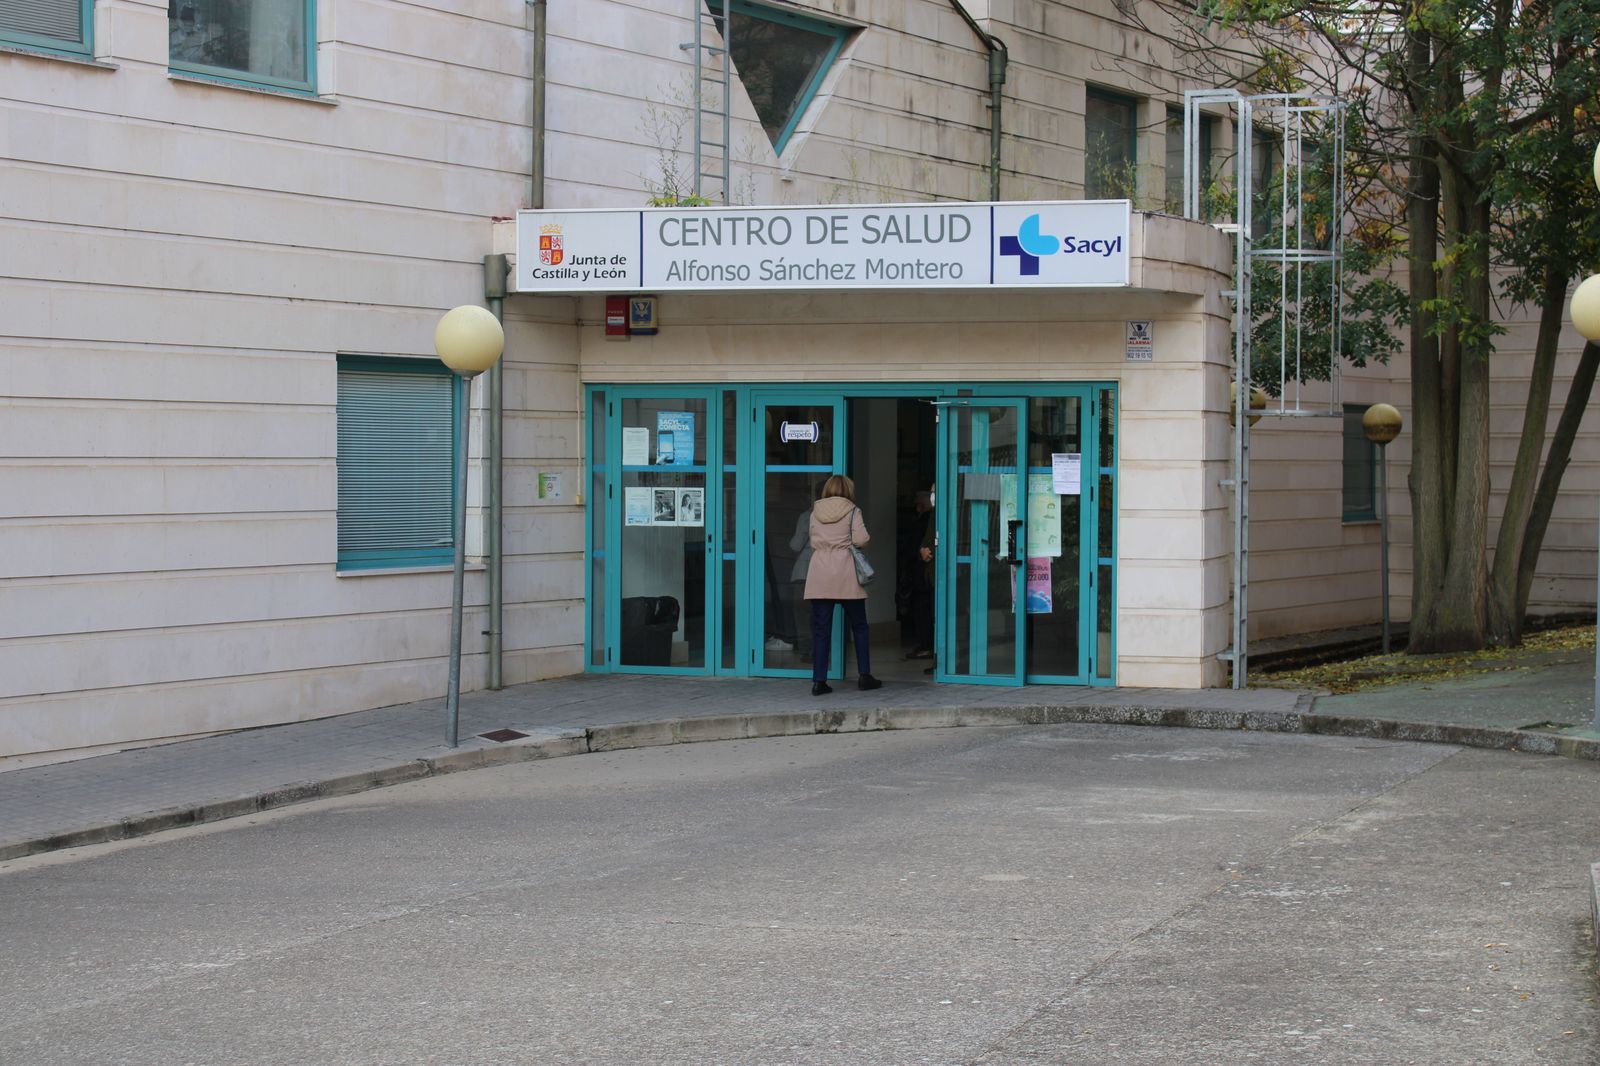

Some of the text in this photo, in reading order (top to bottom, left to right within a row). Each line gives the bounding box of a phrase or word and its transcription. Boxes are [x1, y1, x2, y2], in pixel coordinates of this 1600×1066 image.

[659, 213, 972, 247] CENTRO DE SALUD
[1063, 235, 1122, 257] Sacyl
[568, 254, 627, 265] Junta de
[666, 257, 963, 281] Alfonso Sánchez Montero
[532, 267, 627, 281] Castilla y León
